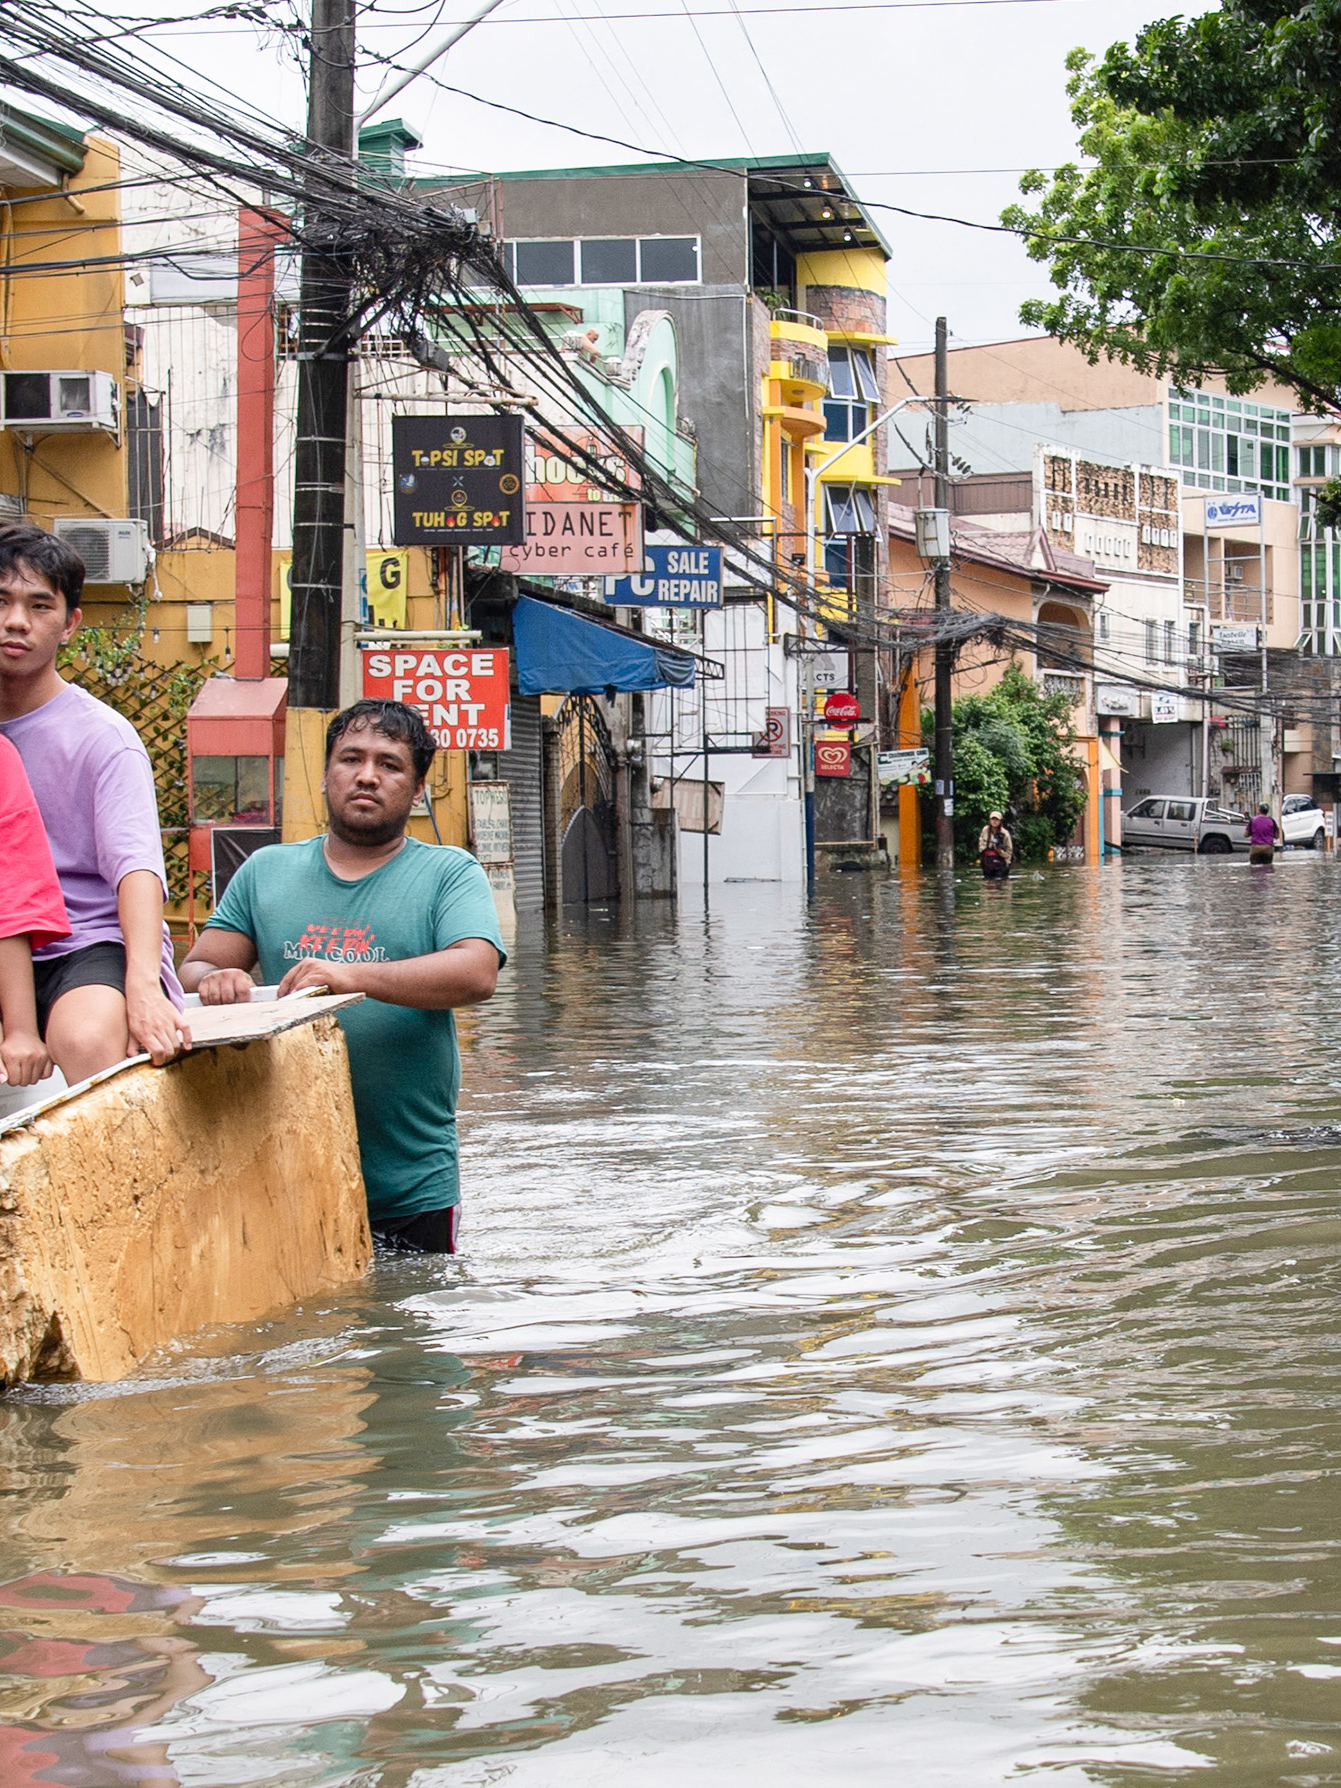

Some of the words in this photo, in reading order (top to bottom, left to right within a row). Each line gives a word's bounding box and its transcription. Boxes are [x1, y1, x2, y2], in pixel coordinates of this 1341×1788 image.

[412, 512, 467, 527] TUHG
[473, 511, 510, 527] SPT
[526, 511, 632, 536] IDANET
[510, 543, 571, 561] cyber
[585, 543, 634, 558] café
[667, 551, 710, 574] SALE
[380, 557, 401, 589] G
[658, 579, 718, 602] REPAIR
[368, 653, 495, 678] SPACE
[393, 678, 472, 702] FOR
[414, 703, 486, 727] ENT
[430, 728, 451, 748] 30
[456, 728, 499, 748] 0735
